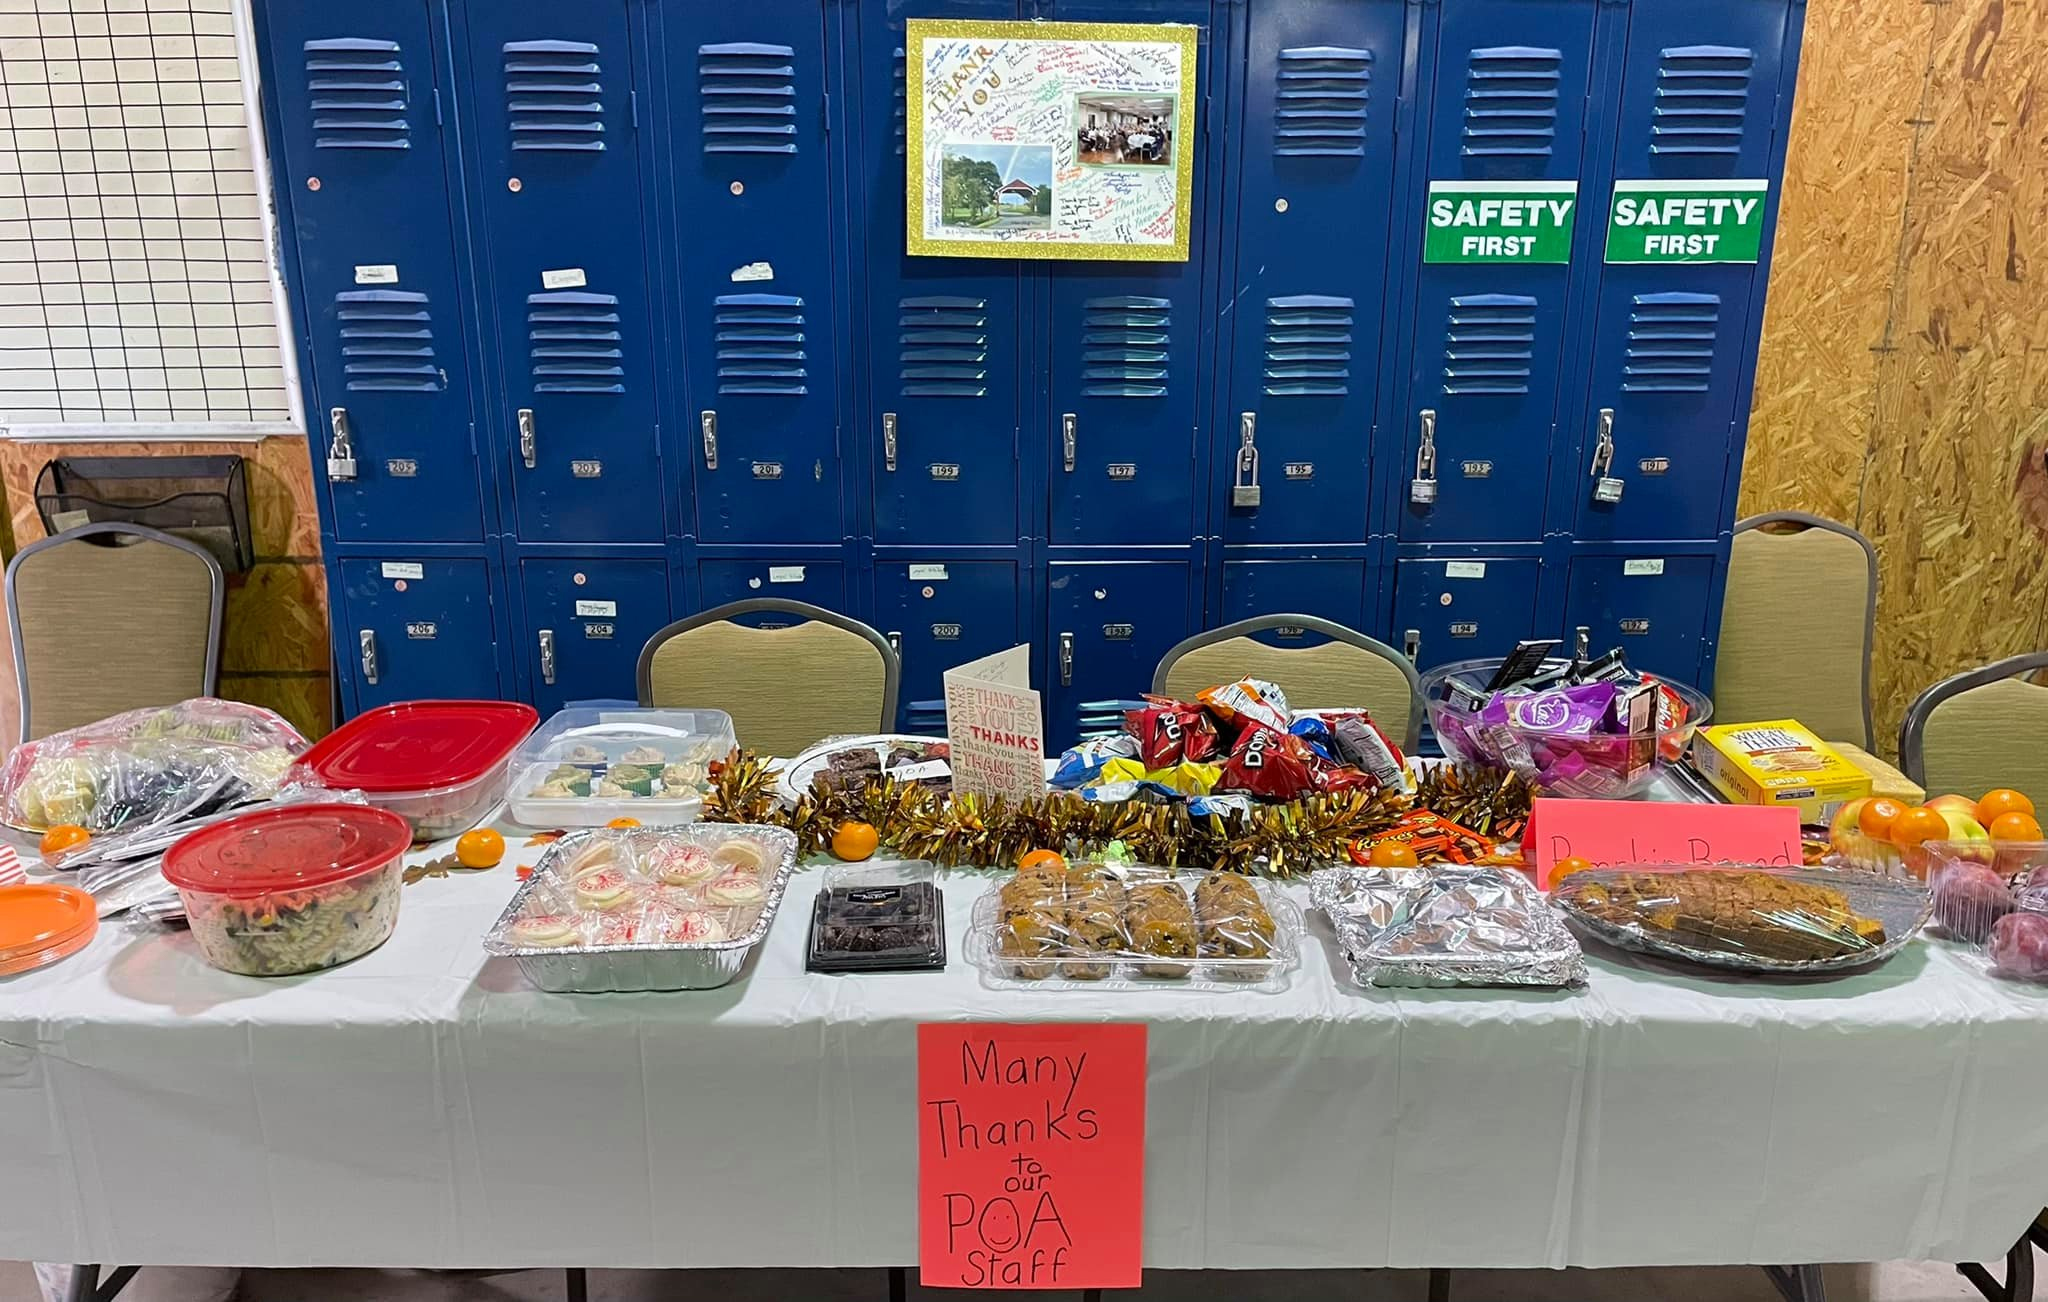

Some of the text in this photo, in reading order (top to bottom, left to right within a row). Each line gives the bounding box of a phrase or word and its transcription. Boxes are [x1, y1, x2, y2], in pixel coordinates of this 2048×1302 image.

[957, 70, 1001, 117] YOU
[1431, 199, 1574, 228] SAFETY
[1613, 198, 1758, 227] SAFETY
[1461, 236, 1537, 257] FIRST
[1643, 234, 1720, 256] FIRST
[577, 463, 597, 473] 203
[759, 464, 775, 474] 201
[936, 466, 955, 476] 199
[1113, 466, 1130, 476] 197
[1290, 465, 1307, 475] 195
[1468, 462, 1485, 473] 193
[1645, 460, 1662, 471] 191
[412, 625, 430, 634] 206
[591, 625, 608, 634] 204
[938, 626, 956, 636] 200
[1455, 624, 1472, 634] 194
[975, 688, 1017, 710] THANK
[976, 705, 1016, 732] YOU
[969, 725, 1039, 752] THANKS
[962, 751, 1017, 777] THANK
[985, 772, 1017, 791] YOU
[961, 1039, 1087, 1112] Many
[926, 1099, 1098, 1158] Thanks
[1010, 1152, 1042, 1174] to
[1004, 1174, 1052, 1193] our
[943, 1191, 1073, 1254] POA
